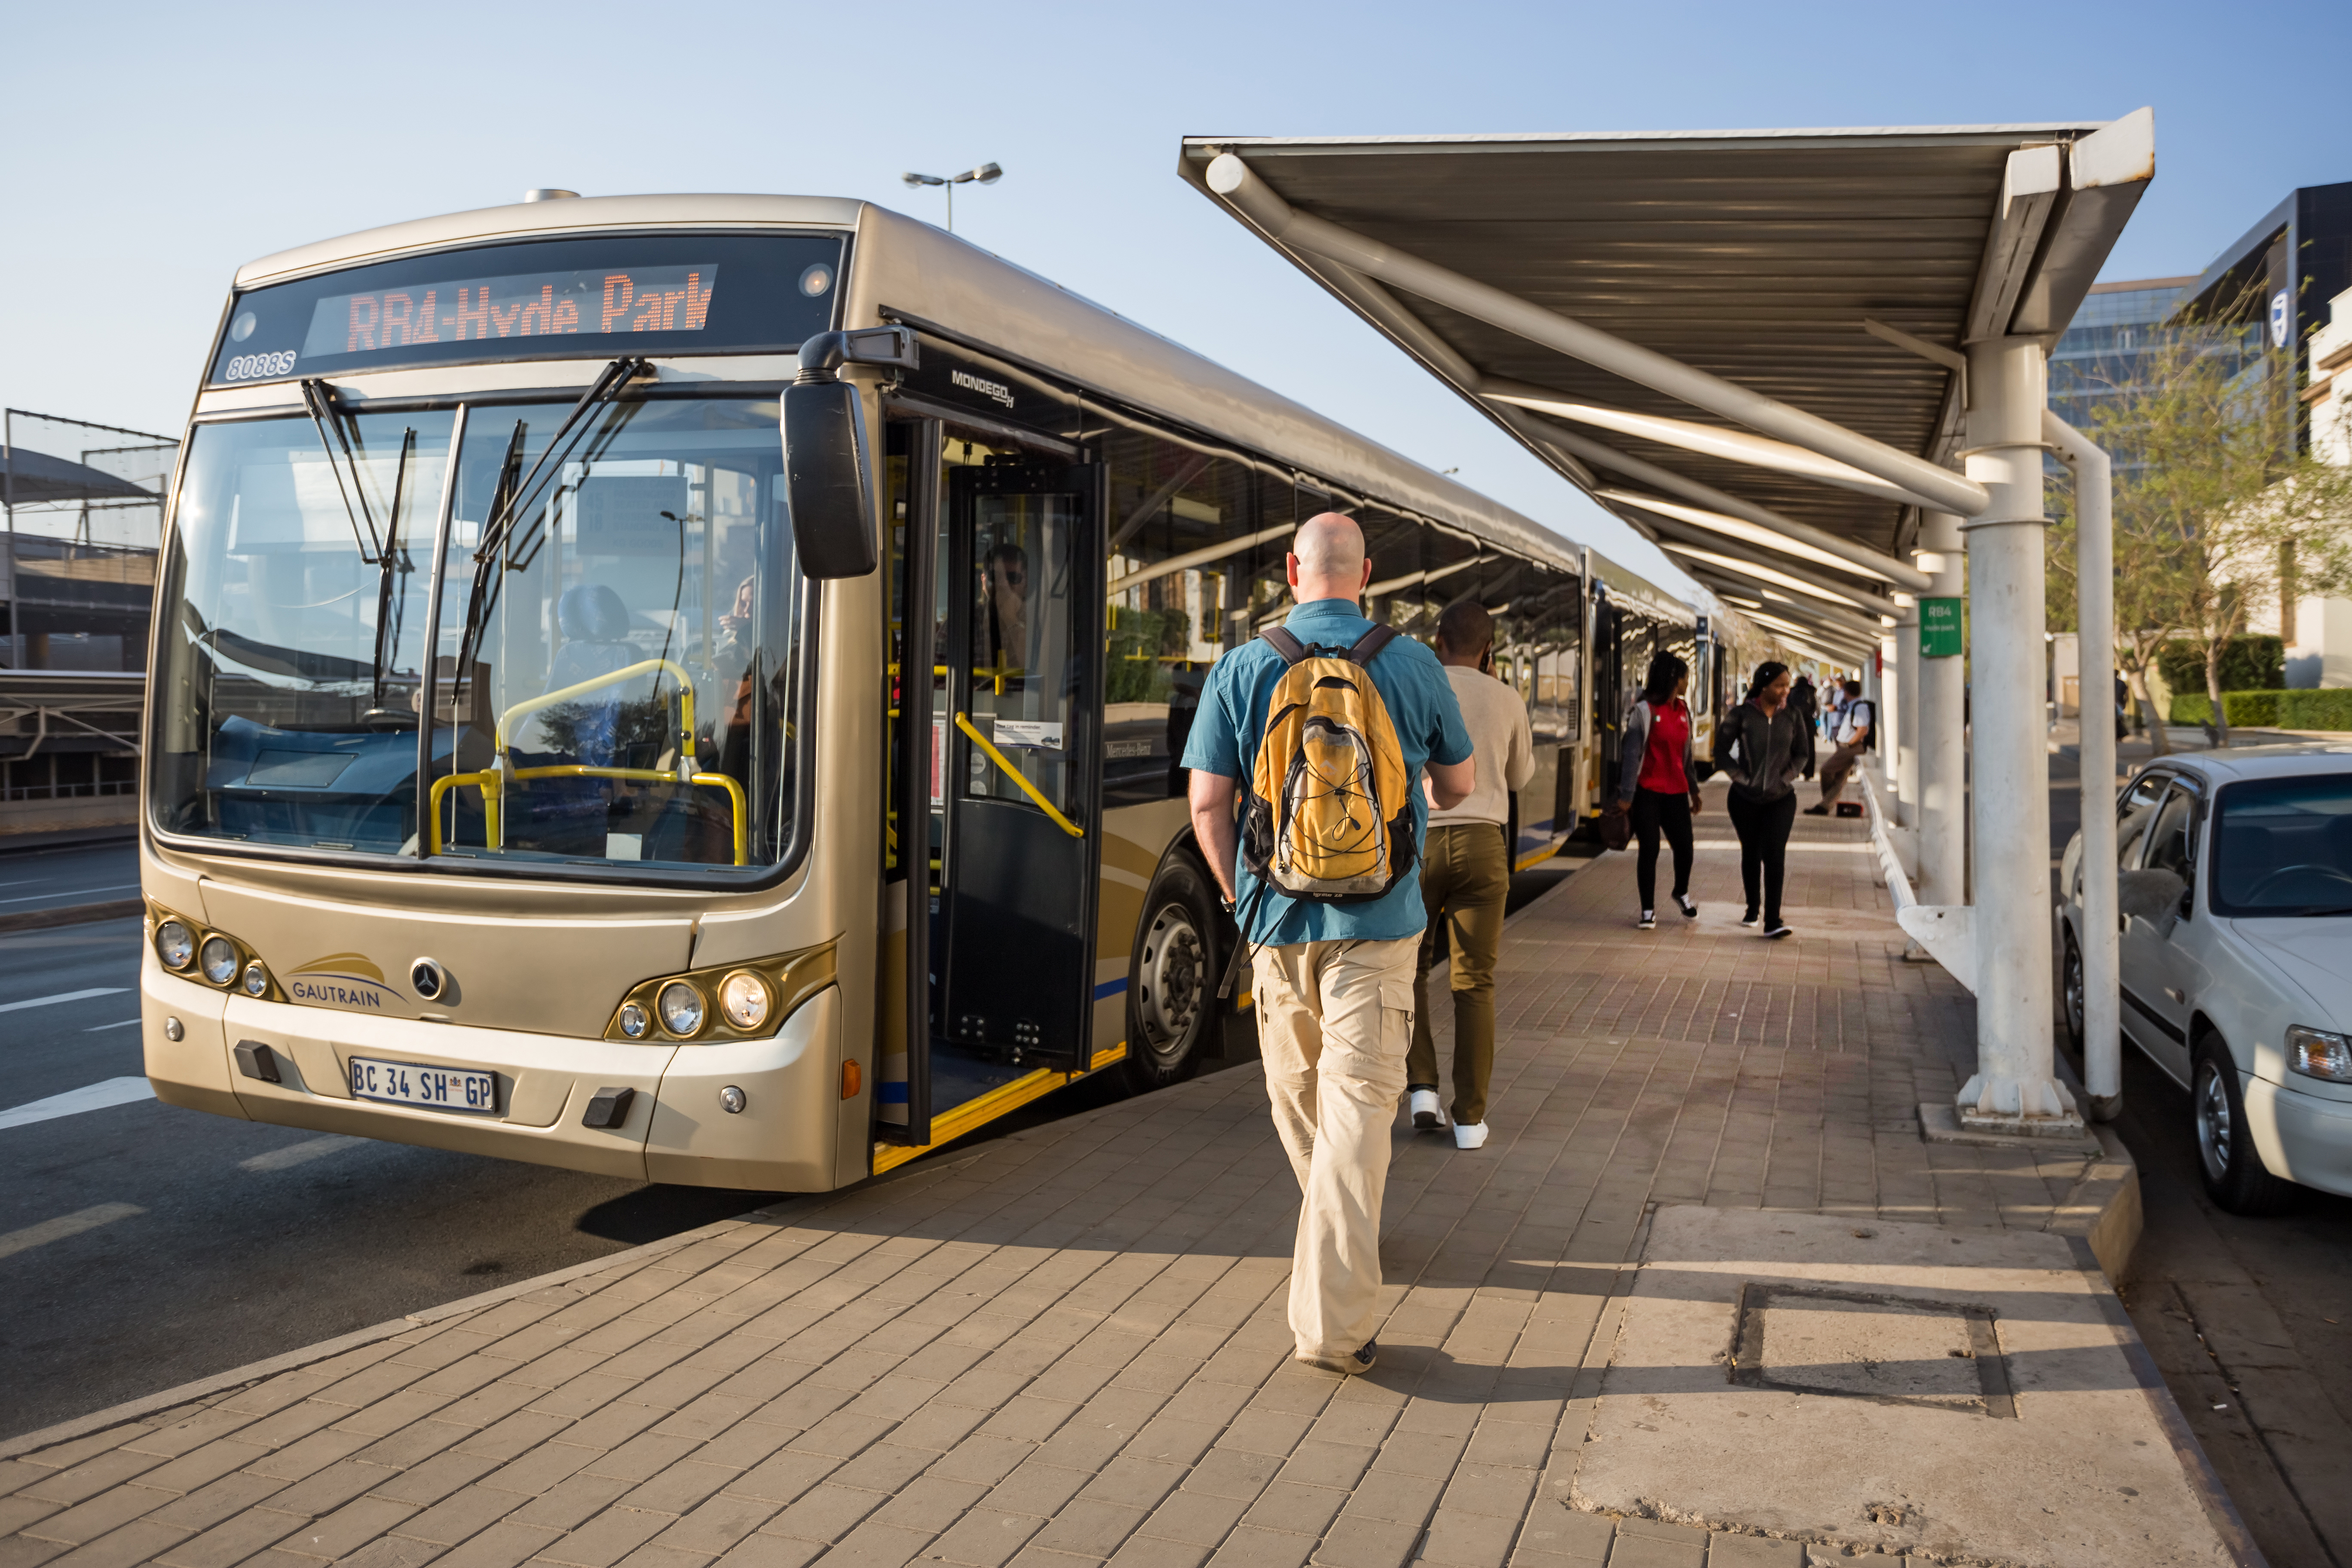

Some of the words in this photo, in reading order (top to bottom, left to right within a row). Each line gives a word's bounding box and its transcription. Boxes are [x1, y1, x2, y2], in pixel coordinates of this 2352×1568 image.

[602, 273, 711, 334] Park
[226, 350, 296, 380] 8088S
[952, 370, 1008, 399] MONDEGO
[293, 982, 380, 1008] GAUTRAIN
[353, 1063, 377, 1092] BC
[387, 1068, 410, 1097] 34
[420, 1072, 447, 1101] SH
[466, 1077, 490, 1106] GP
